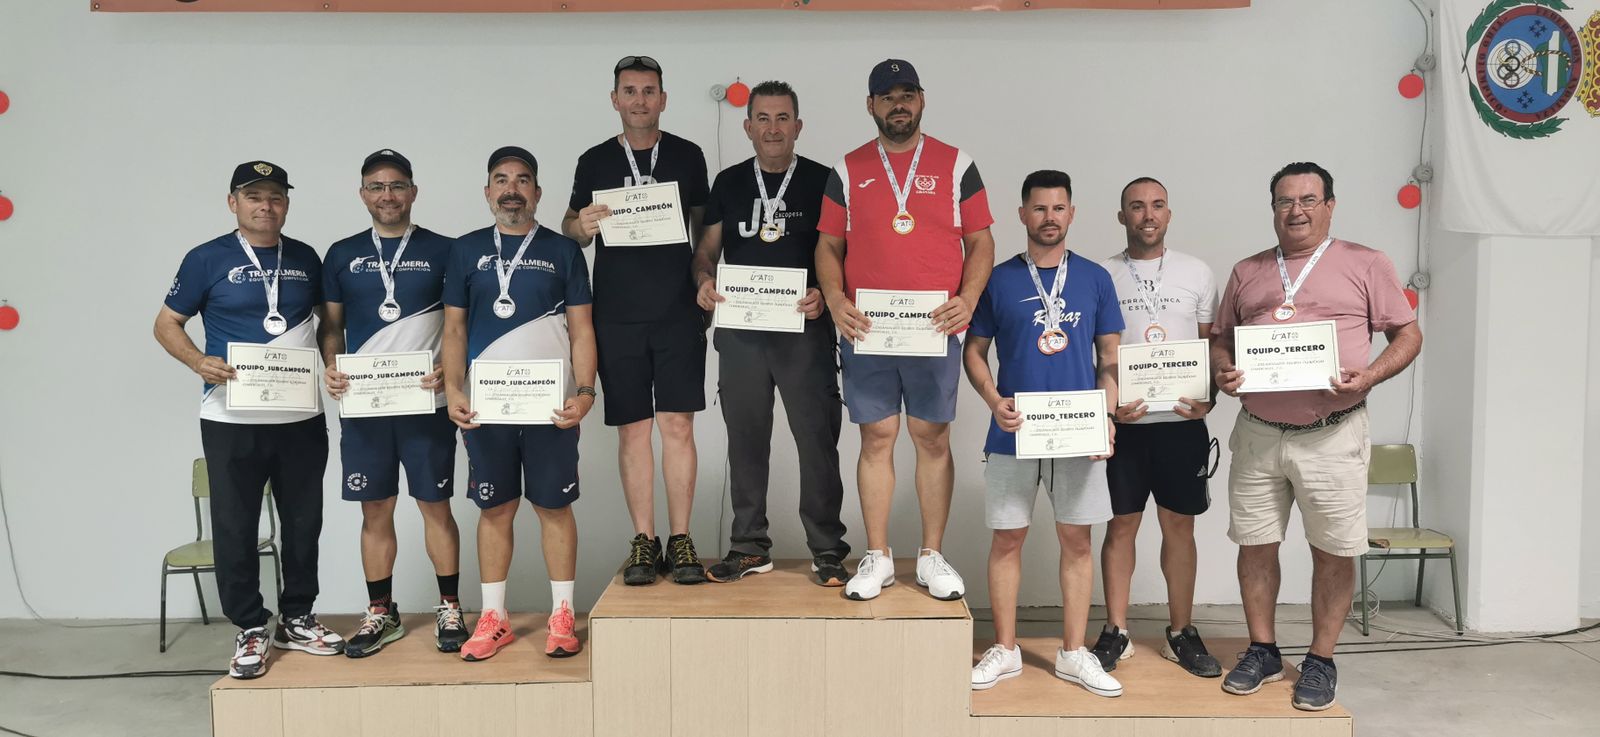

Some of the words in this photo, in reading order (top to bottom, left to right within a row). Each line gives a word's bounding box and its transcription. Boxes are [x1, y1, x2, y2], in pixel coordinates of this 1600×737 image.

[610, 203, 673, 216] UIPO_CAMPEÓN
[397, 260, 430, 268] LMERIA
[725, 285, 797, 296] EQUIPO_CAMPEÓN
[1246, 344, 1326, 355] EQUIPO_TERCERO
[1128, 360, 1198, 371] EQUIPO_TERCERO
[347, 370, 426, 381] QUIPO_SUBCAMPEÓN
[1026, 411, 1096, 421] EQUIPO_TERCERO
